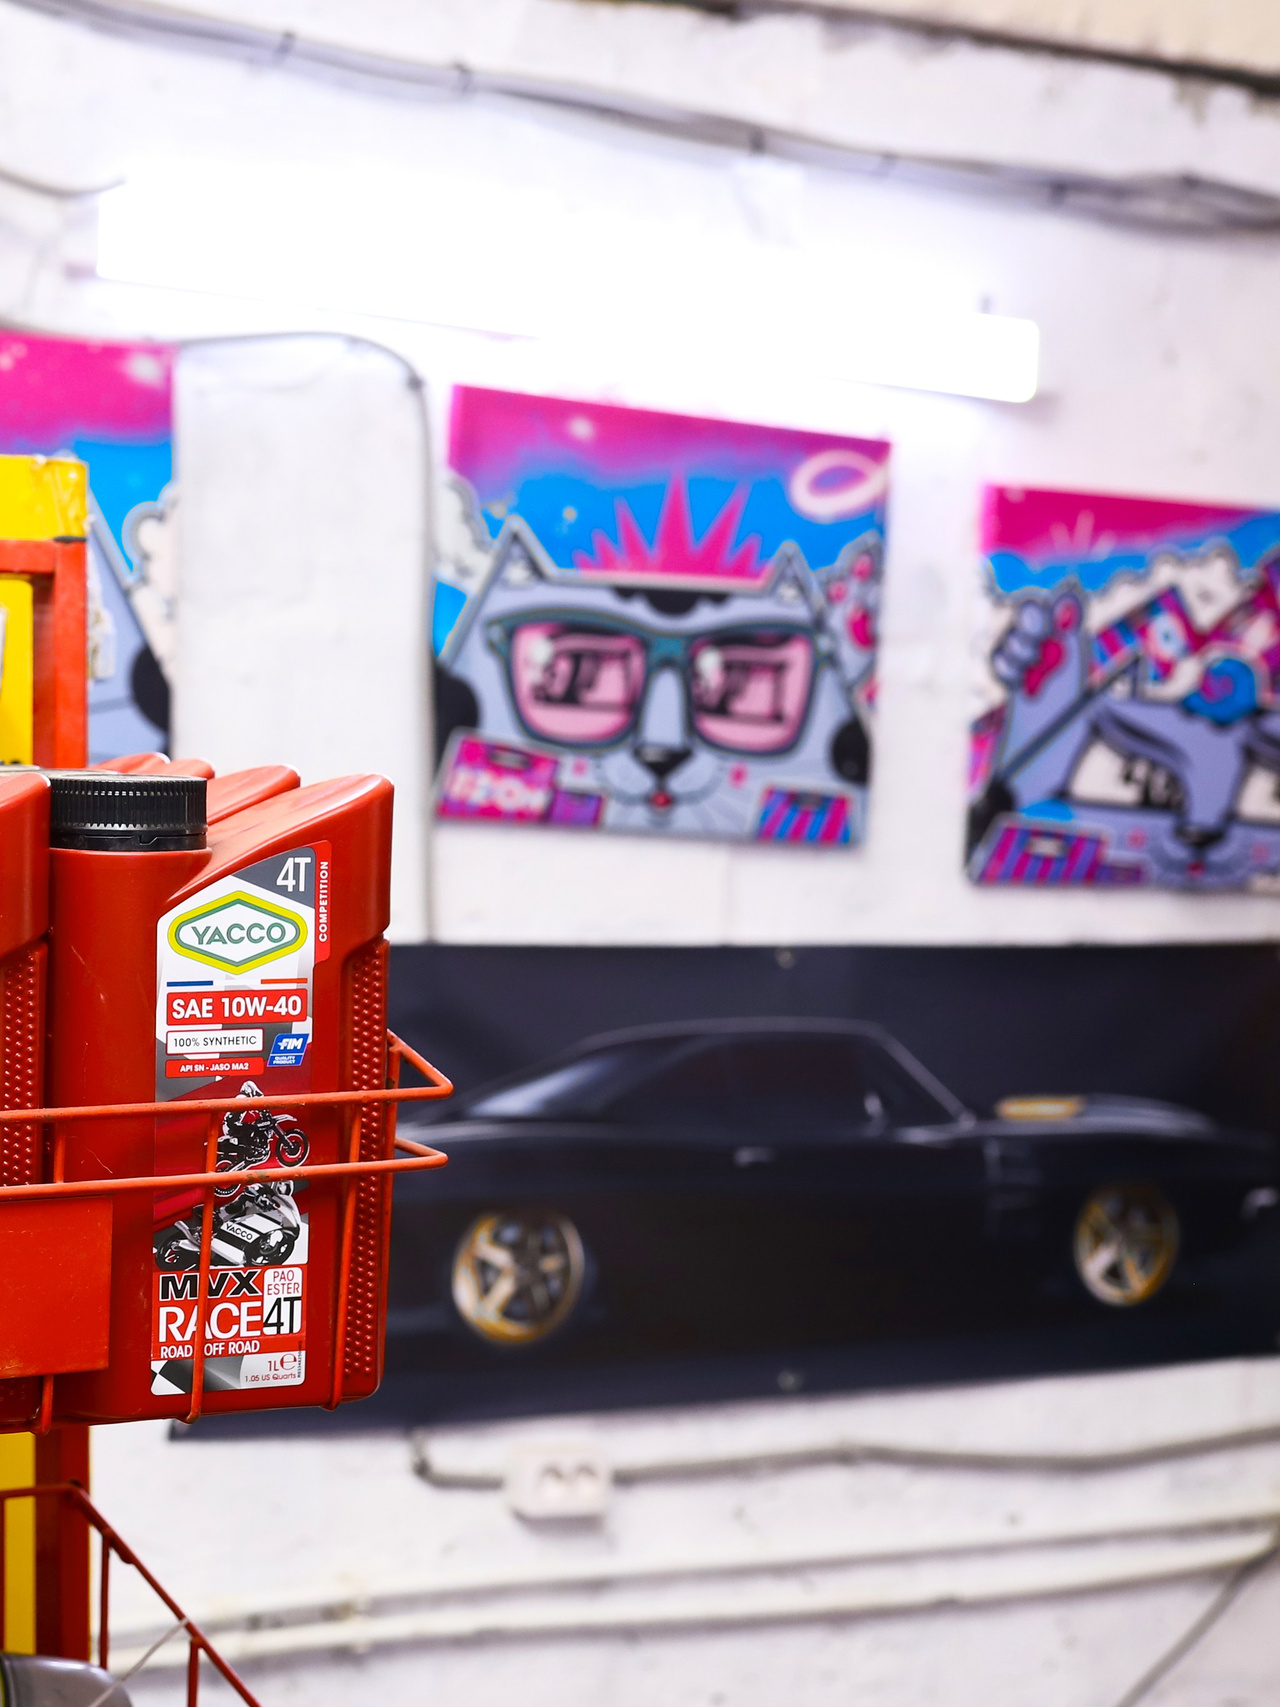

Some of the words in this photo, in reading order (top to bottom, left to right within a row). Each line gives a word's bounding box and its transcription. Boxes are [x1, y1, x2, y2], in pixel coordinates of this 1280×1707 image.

[276, 857, 312, 892] 4T
[319, 861, 329, 942] COMPETITION
[191, 922, 286, 945] YACCO
[172, 998, 213, 1019] SAE
[221, 995, 302, 1018] 10W-40
[173, 1037, 200, 1047] 100%
[203, 1035, 257, 1046] SYNTHETIC
[278, 1037, 304, 1050] FIM
[180, 1064, 193, 1072] API
[194, 1064, 205, 1072] SN
[210, 1063, 231, 1071] JASO
[232, 1062, 249, 1071] MA2
[226, 1222, 253, 1241] YACCO
[159, 1269, 262, 1301] MVX
[273, 1270, 295, 1282] PAO
[267, 1282, 300, 1296] ESTER
[159, 1301, 262, 1343] RACE
[263, 1297, 302, 1334] 4T
[160, 1345, 193, 1359] ROAD
[204, 1342, 226, 1356] OFF
[228, 1340, 260, 1354] ROAD
[272, 1372, 296, 1380] Quarts
